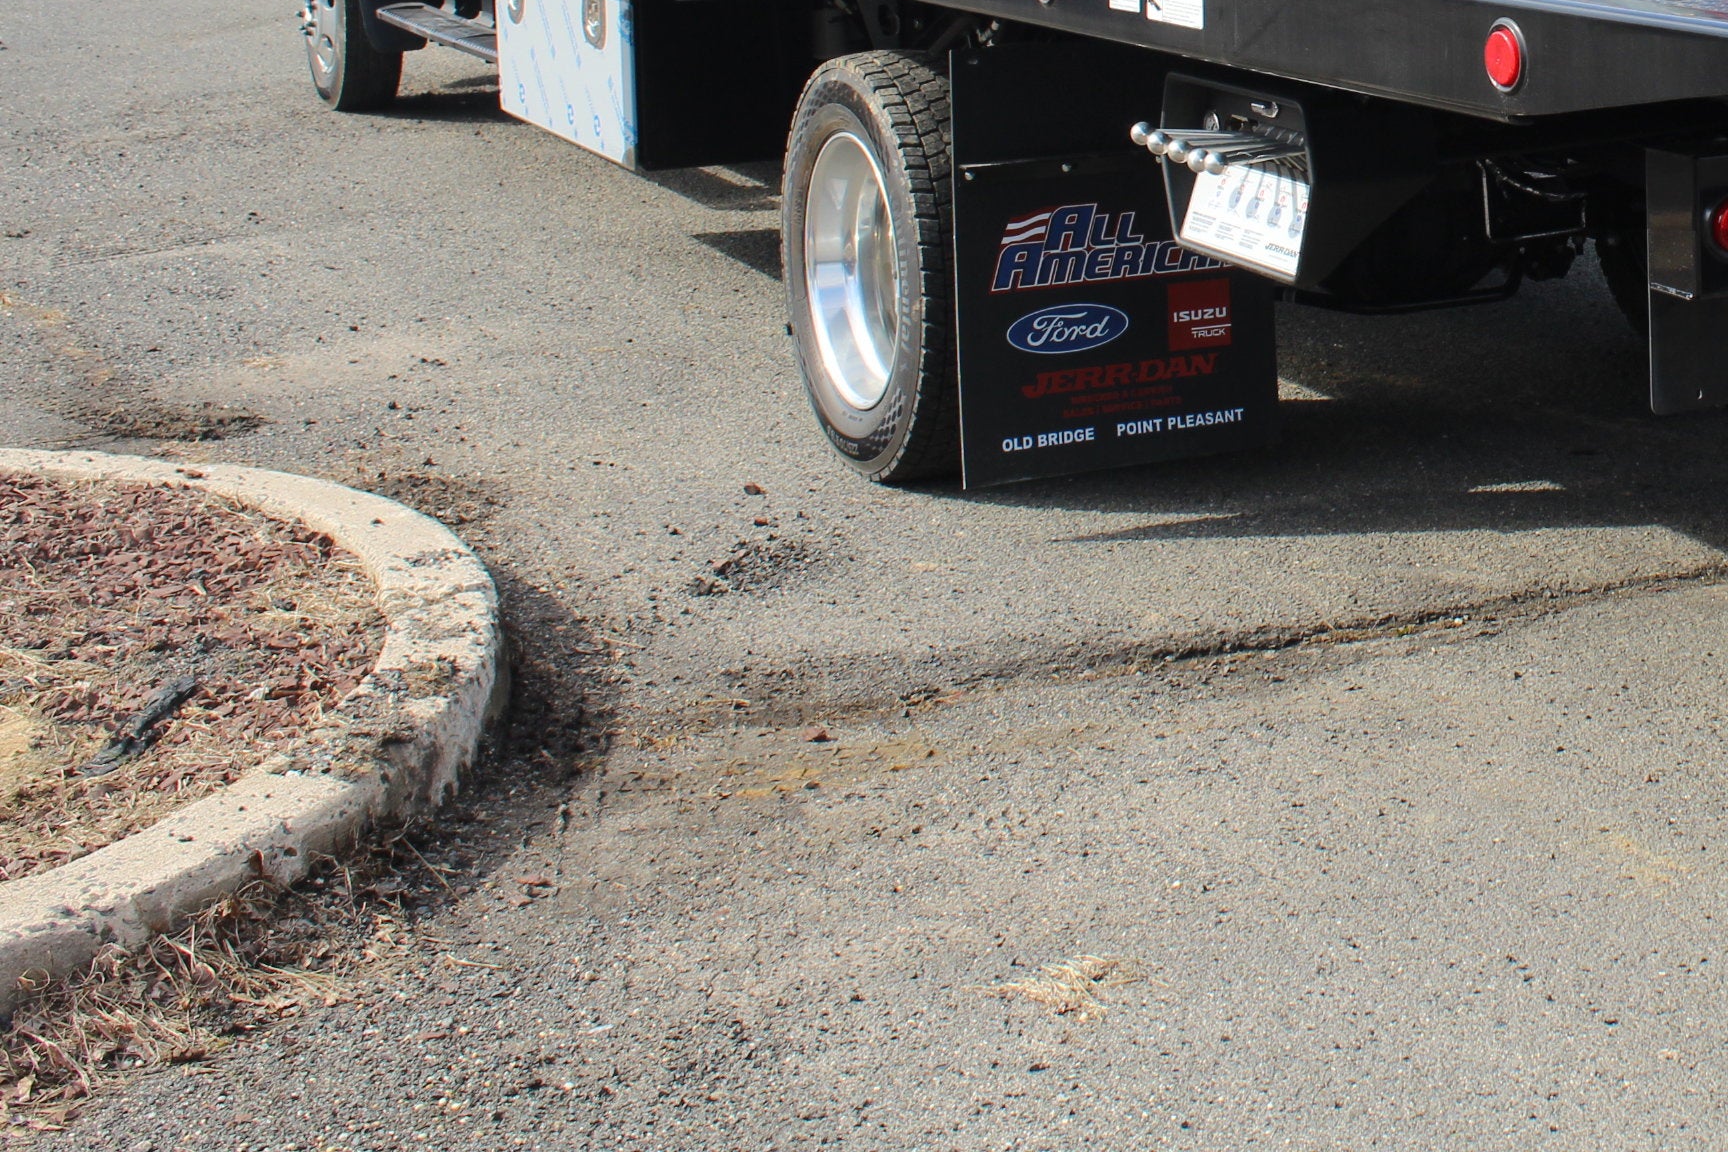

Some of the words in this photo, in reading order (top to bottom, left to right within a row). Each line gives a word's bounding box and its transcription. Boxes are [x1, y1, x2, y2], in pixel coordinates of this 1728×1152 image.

[1043, 202, 1144, 254] ALL
[991, 239, 1234, 292] AMERICA
[1026, 311, 1111, 348] Ford
[1173, 306, 1228, 323] ISUZU
[1191, 327, 1227, 340] TRUCK
[1021, 353, 1219, 399] JERR-DAN
[1002, 437, 1033, 453] OLD
[1037, 427, 1095, 448] BRIDGE
[1116, 419, 1163, 437] POINT
[1167, 408, 1245, 431] PLEASANT
